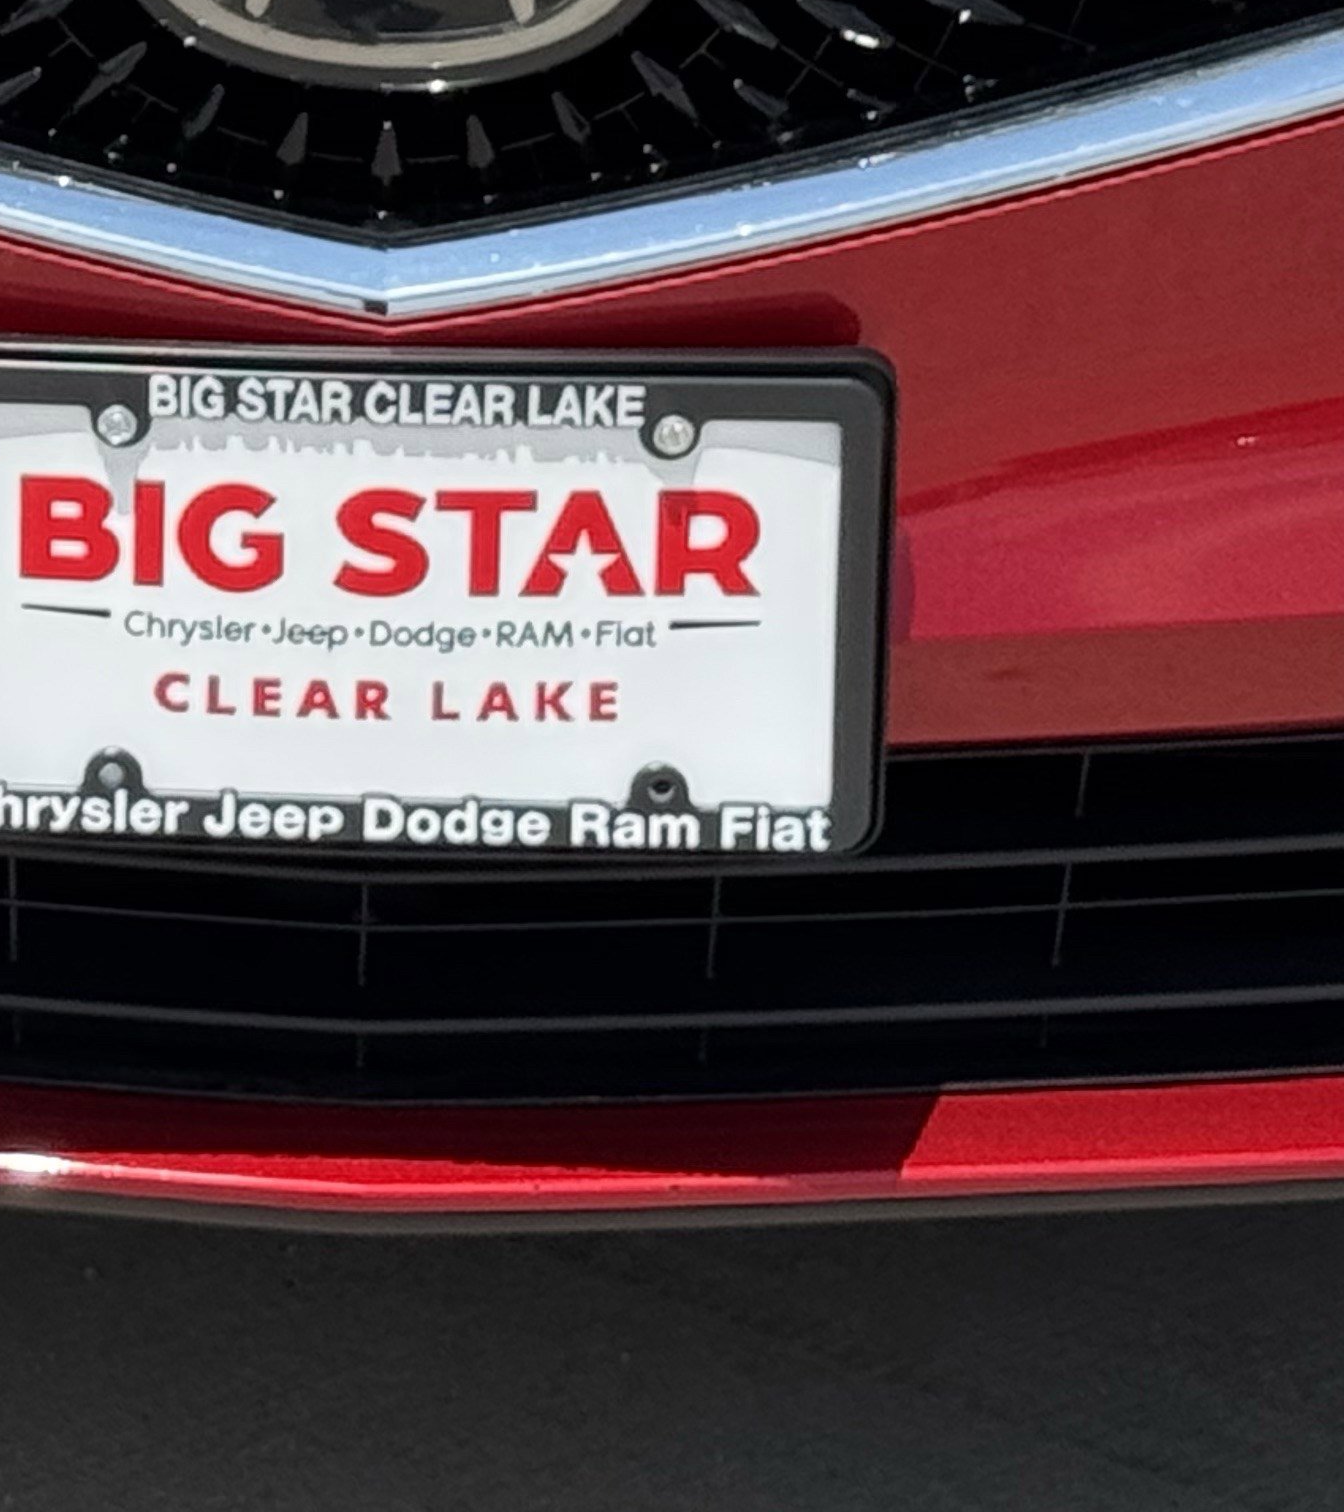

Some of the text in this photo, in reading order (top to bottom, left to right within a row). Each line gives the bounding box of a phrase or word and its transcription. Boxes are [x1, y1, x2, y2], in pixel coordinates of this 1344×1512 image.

[148, 374, 646, 427] BIG STAR CLEAR LAKE
[19, 474, 761, 598] BIG STAR
[154, 671, 619, 722] CLEAR LAKE
[204, 790, 344, 841] Jeep
[362, 797, 550, 847] Dodge
[570, 803, 700, 849] Ram
[720, 805, 832, 852] Fiat
